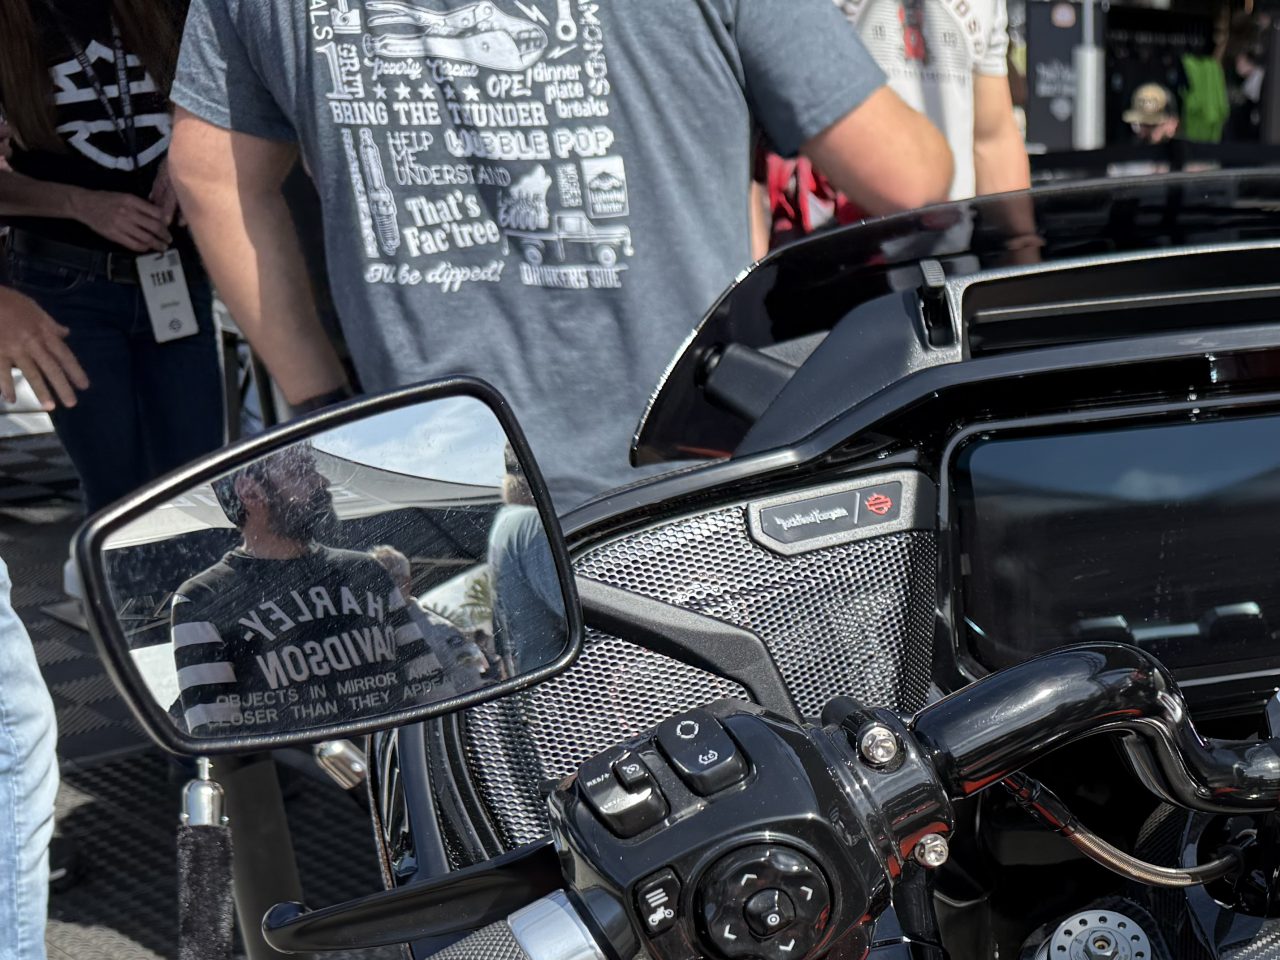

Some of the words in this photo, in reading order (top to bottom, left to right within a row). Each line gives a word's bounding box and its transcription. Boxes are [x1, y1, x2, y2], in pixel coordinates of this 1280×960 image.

[577, 0, 612, 96] MONDS
[337, 43, 366, 99] GRIT
[486, 67, 532, 99] OPE!
[533, 62, 582, 82] dinner
[545, 81, 584, 105] plate
[555, 95, 610, 118] breaks
[329, 101, 389, 125] BRING
[393, 101, 442, 126] THE
[447, 101, 549, 127] THUNDER
[386, 130, 434, 151] HELP
[553, 125, 615, 158] POP
[389, 148, 417, 169] ME
[394, 164, 511, 187] UNDERSTAND
[404, 189, 482, 227] That's
[402, 220, 500, 257] Fac'tree
[425, 260, 506, 293] dipped!
[207, 708, 279, 729] LOSER
[292, 700, 338, 719] THAN
[350, 690, 392, 712] THEY
[403, 675, 461, 701] APPEA
[216, 688, 299, 708] OBJECTS
[310, 682, 327, 699] IN
[337, 672, 398, 696] MIRROR
